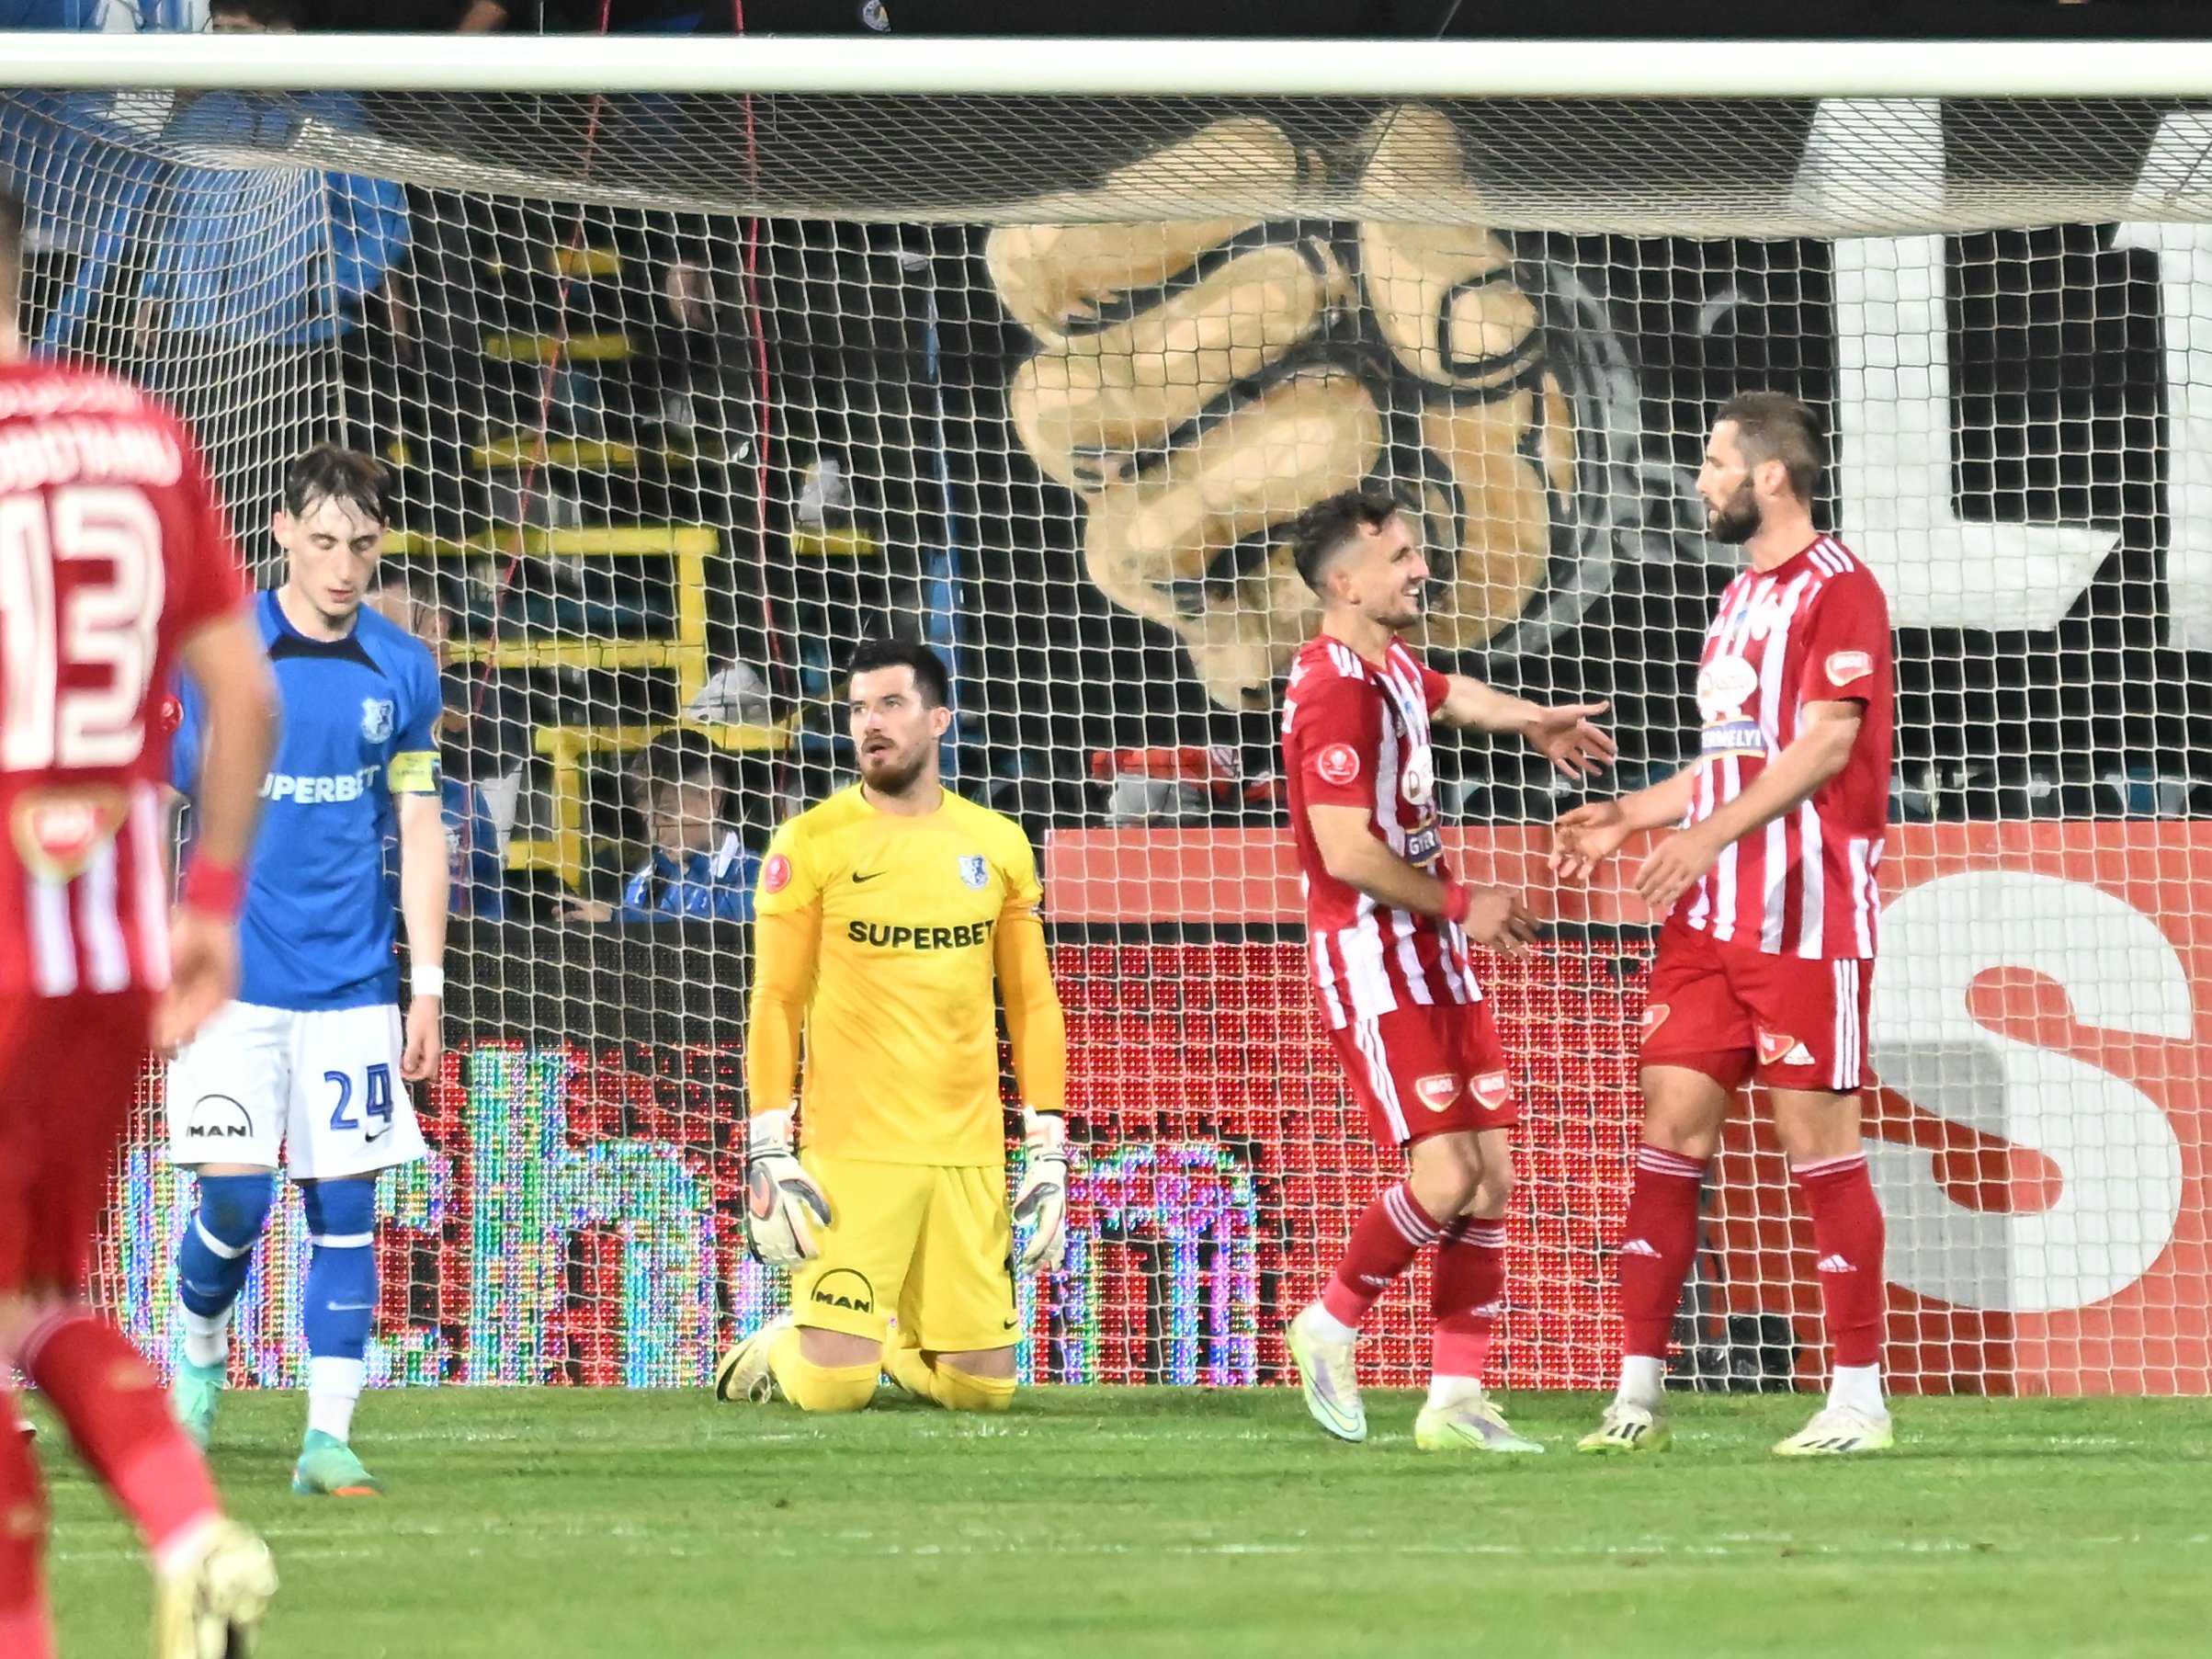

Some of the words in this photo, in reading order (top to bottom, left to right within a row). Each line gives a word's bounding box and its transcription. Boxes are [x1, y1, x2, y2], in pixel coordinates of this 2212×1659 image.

[0, 484, 165, 772] 13
[847, 919, 995, 950] SUPERBET
[323, 1062, 393, 1131] 24
[189, 1125, 247, 1138] MAN
[816, 1291, 869, 1313] MAN
